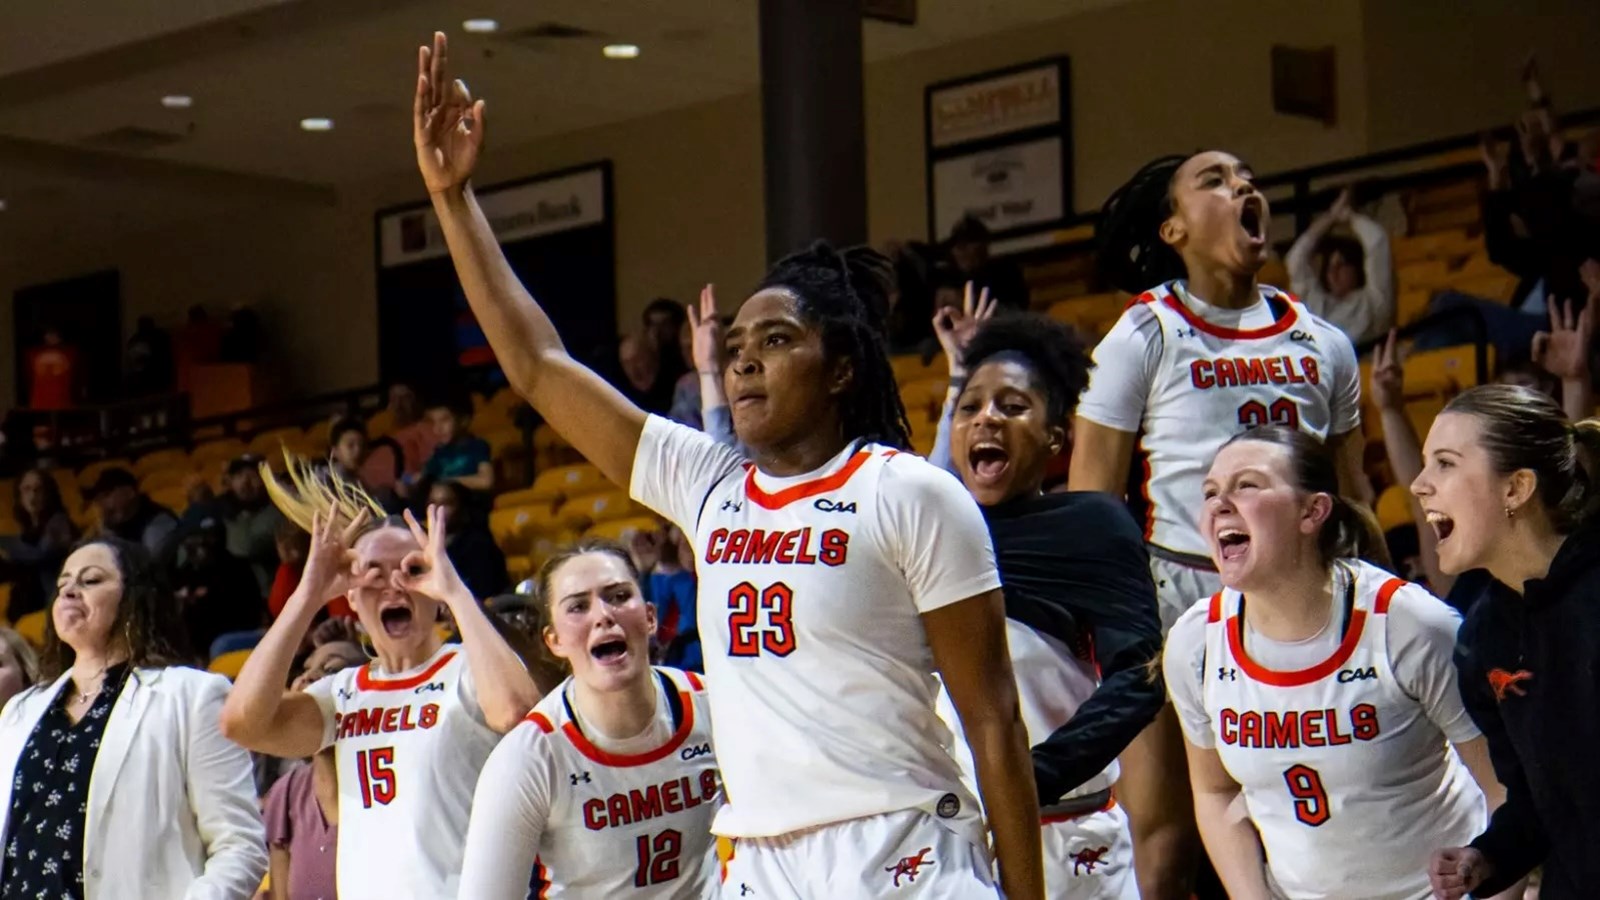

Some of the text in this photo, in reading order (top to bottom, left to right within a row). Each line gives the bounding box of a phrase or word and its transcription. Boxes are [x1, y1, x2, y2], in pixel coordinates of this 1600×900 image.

[1190, 356, 1319, 390] CAMELS
[814, 498, 857, 514] CAA
[705, 527, 850, 567] CAMELS
[728, 581, 797, 657] 23
[1337, 667, 1378, 683] CAA
[1220, 703, 1380, 748] CAMELS
[681, 743, 711, 760] CAA
[357, 746, 396, 809] 15
[583, 768, 718, 831] CAMELS
[1283, 764, 1331, 827] 9
[634, 828, 682, 888] 12
